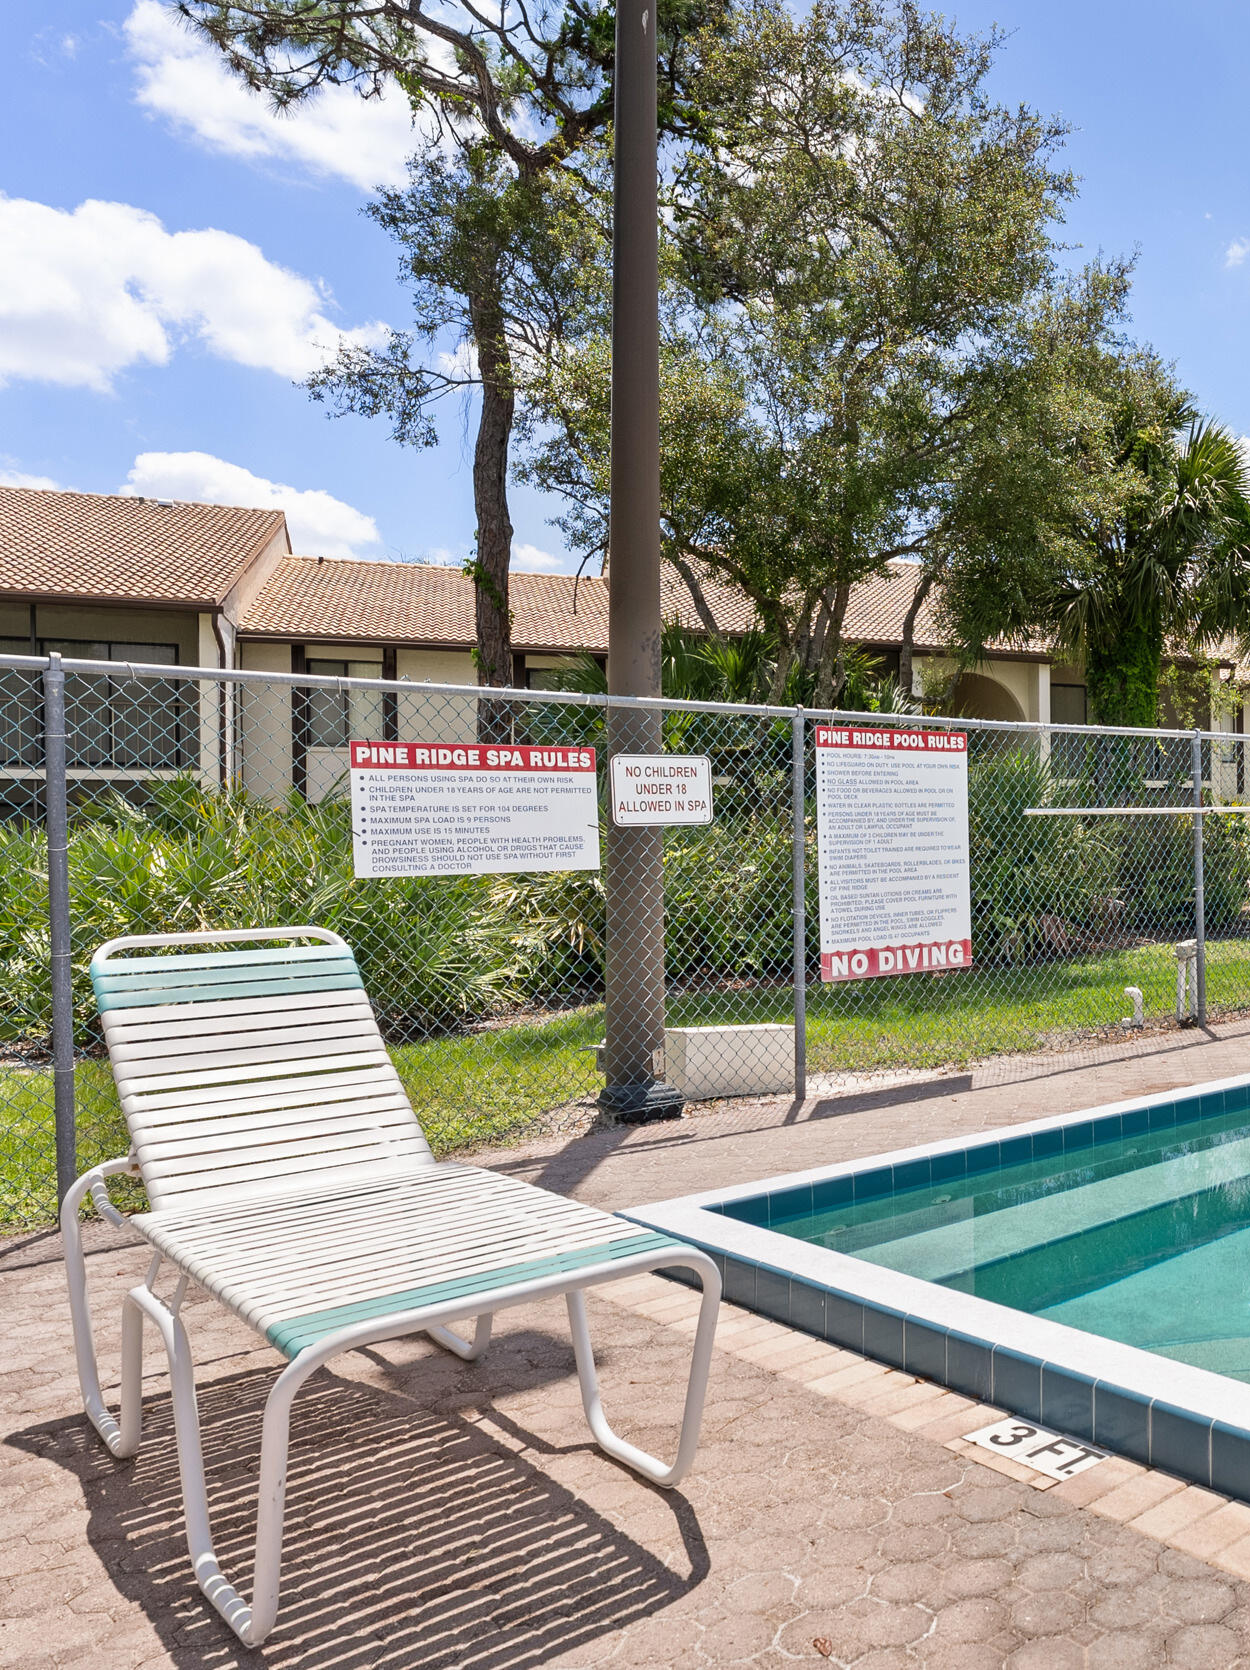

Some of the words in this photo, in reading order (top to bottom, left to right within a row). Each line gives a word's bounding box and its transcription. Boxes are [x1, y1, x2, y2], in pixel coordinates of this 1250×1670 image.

[819, 730, 849, 745] PINE
[853, 732, 891, 746] RIDGE
[894, 734, 924, 747] POOL
[928, 735, 964, 749] RULES
[356, 747, 409, 765] PINE
[416, 748, 480, 766] RIDGE
[486, 750, 524, 767] SPA
[530, 751, 591, 768] RULES
[626, 766, 641, 777] NO
[645, 766, 697, 777] CHILDREN
[388, 775, 429, 783] PERSONS
[431, 775, 456, 783] USING
[513, 776, 536, 784] THEIR
[636, 784, 672, 794] UNDER
[676, 784, 687, 794] 18
[369, 794, 379, 802] IN
[380, 794, 397, 802] THE
[619, 801, 671, 812] ALLOWED
[675, 801, 684, 811] IN
[688, 800, 707, 811] SPA
[371, 828, 412, 836] MAXIMUM
[434, 827, 441, 835] IS
[371, 839, 418, 847] PREGNANT
[420, 838, 455, 846] WOMEN,
[490, 837, 509, 845] WITH
[392, 847, 427, 855] PEOPLE
[429, 846, 454, 854] USING
[372, 855, 429, 864] DROWSINESS
[431, 854, 465, 862] SHOULD
[485, 853, 502, 861] USE
[519, 852, 554, 860] WITHOUT
[556, 851, 577, 859] FIRST
[372, 864, 427, 872] CONSULTING
[438, 862, 472, 870] DOCTOR
[831, 953, 869, 977] NO
[879, 944, 964, 972] DIVING
[990, 1426, 1037, 1446] 3
[1026, 1438, 1106, 1475] FT.
